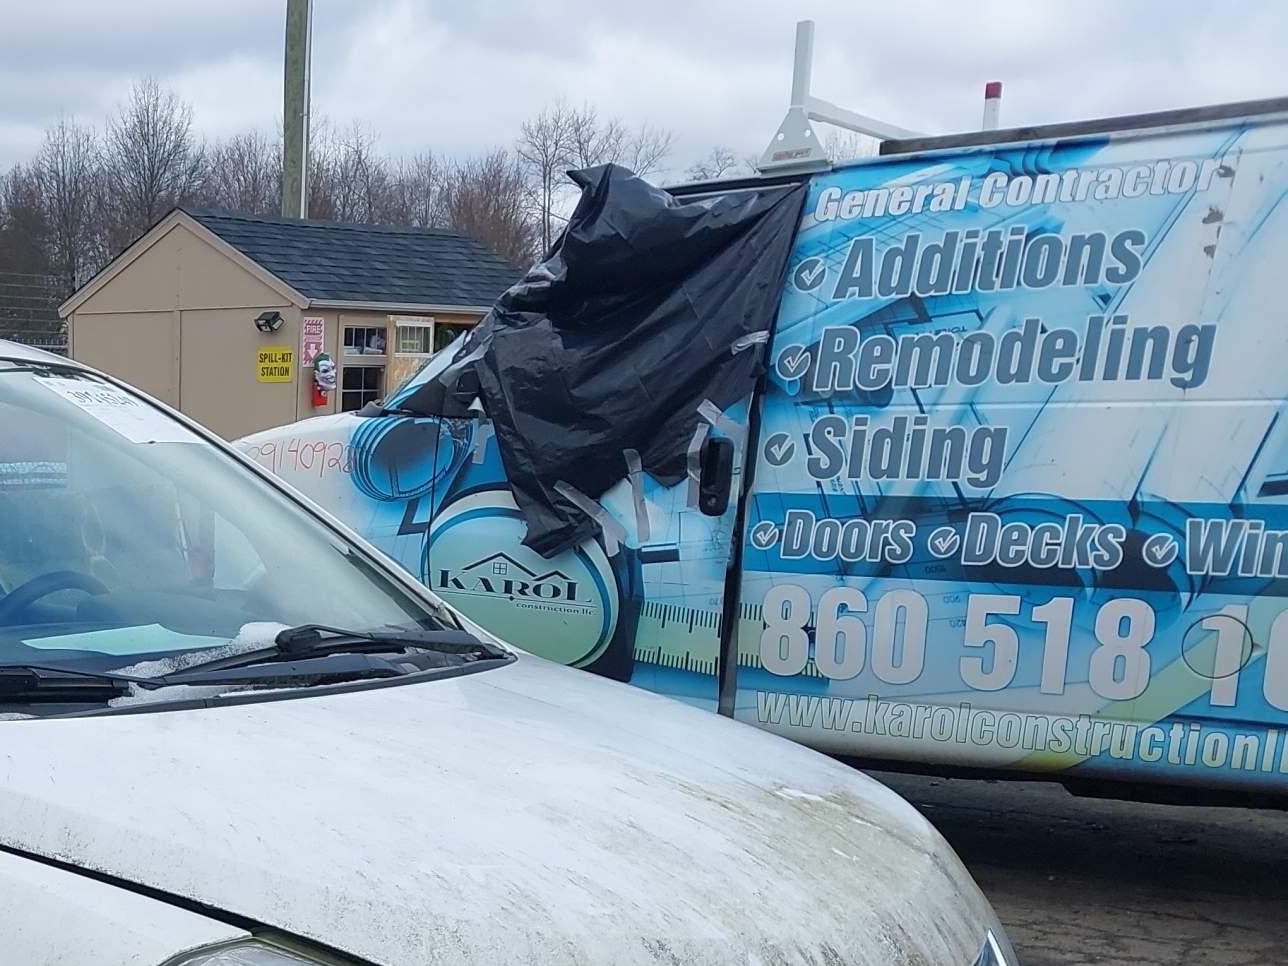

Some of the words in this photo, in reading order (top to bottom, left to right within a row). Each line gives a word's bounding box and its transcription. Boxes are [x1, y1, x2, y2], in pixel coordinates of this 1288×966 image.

[815, 176, 969, 221] General
[979, 158, 1221, 208] Contractor
[833, 225, 1146, 300] Additions
[259, 352, 293, 363] SPILL-KIT
[261, 366, 290, 377] STATION
[813, 315, 1216, 391] Remodeling
[807, 415, 1008, 488] Siding
[780, 509, 916, 564] Doors
[961, 512, 1126, 570] Decks
[439, 569, 592, 603] KAROL
[516, 602, 579, 615] construction
[759, 584, 930, 685] 860
[959, 593, 1157, 701] 518
